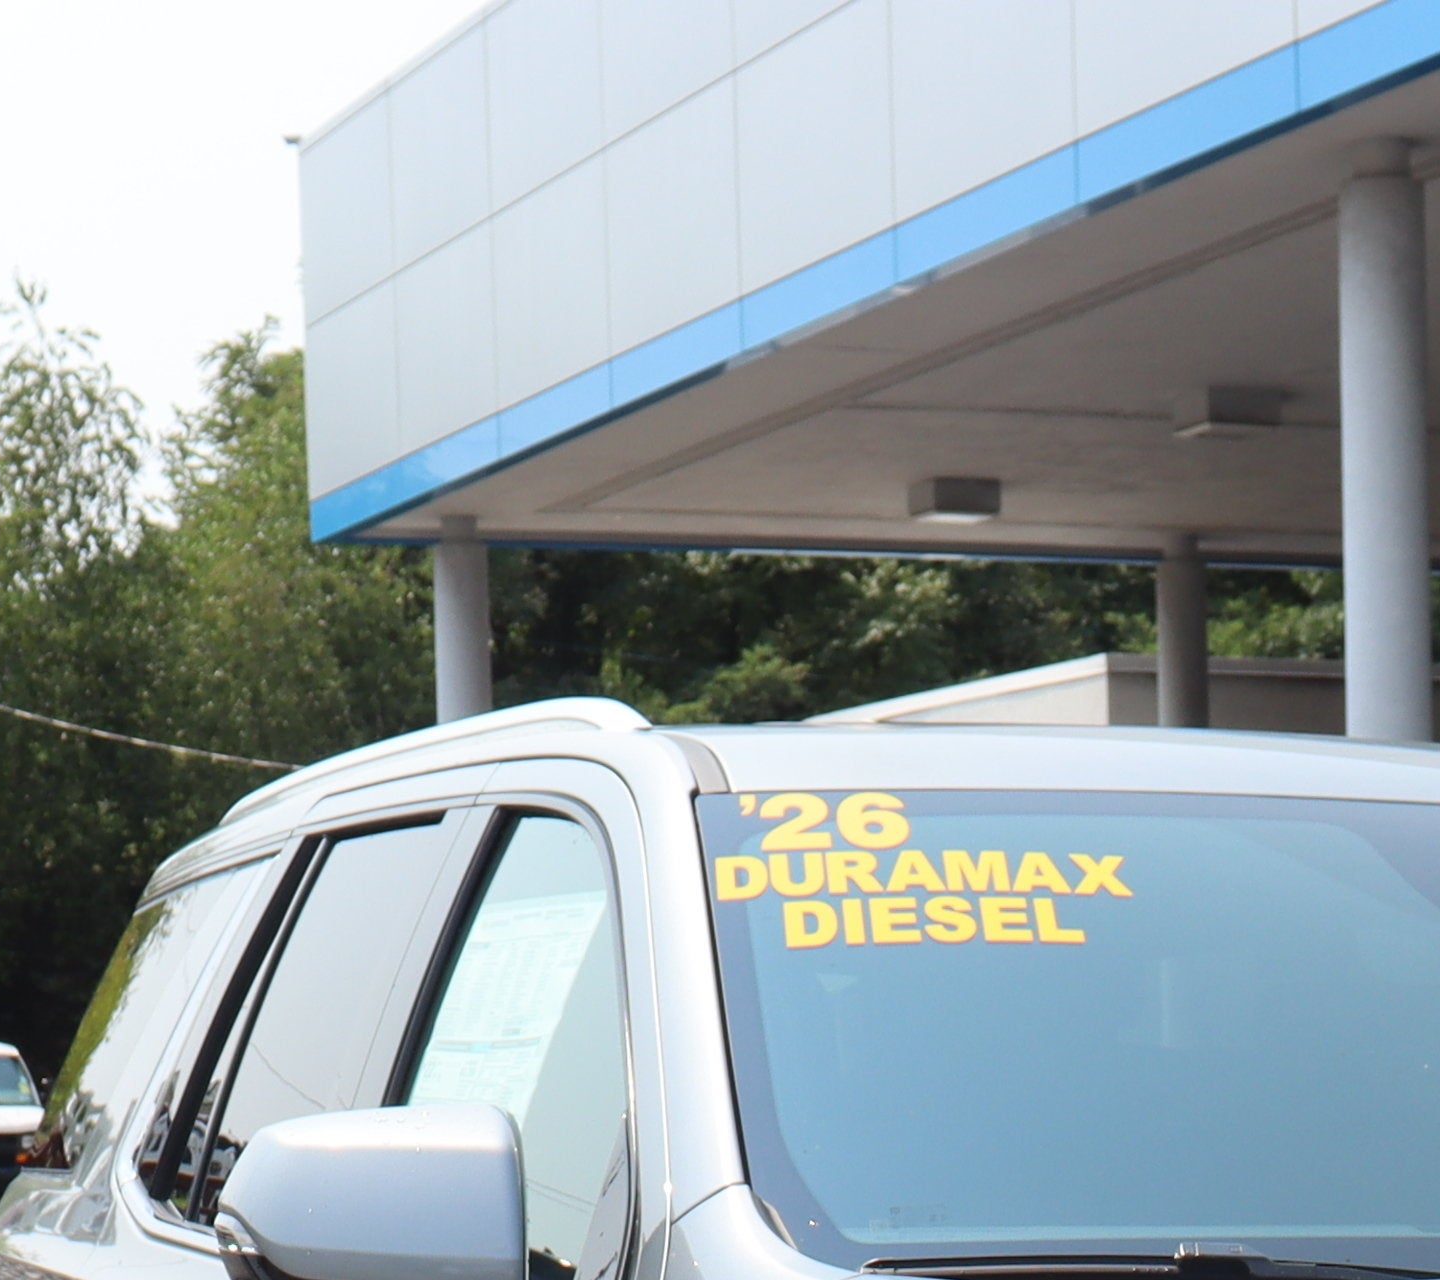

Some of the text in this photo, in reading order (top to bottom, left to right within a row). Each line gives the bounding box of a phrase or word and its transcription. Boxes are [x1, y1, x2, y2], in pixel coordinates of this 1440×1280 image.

[739, 793, 910, 850] '26
[714, 850, 1134, 901] DURAMAX
[782, 897, 1086, 949] DIESEL
